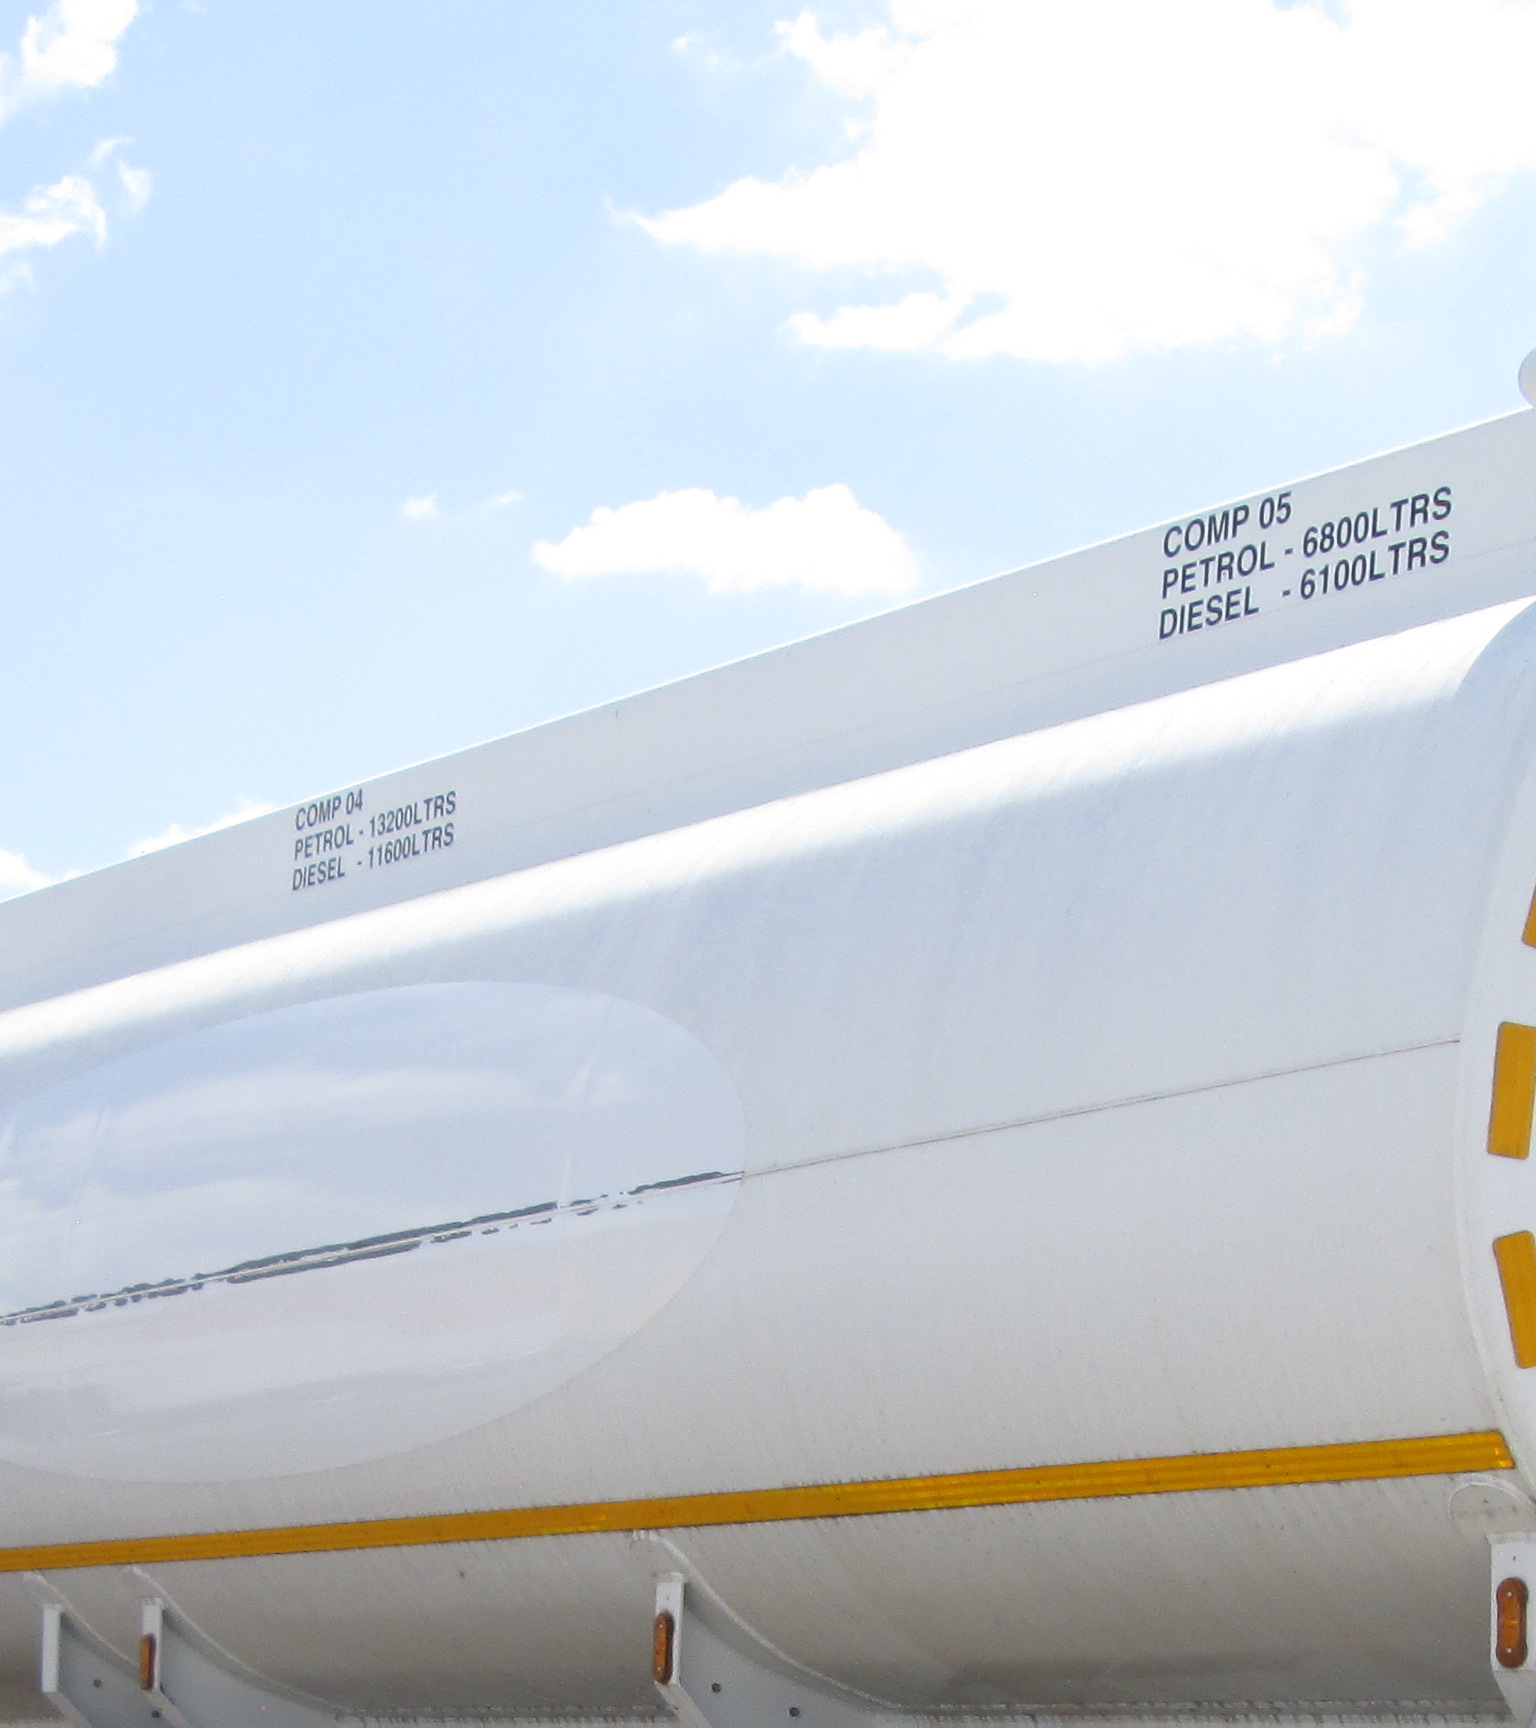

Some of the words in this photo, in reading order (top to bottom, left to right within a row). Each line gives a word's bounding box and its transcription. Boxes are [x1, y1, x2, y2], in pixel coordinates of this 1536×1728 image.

[1162, 541, 1275, 599] PETROL
[1302, 486, 1452, 558] 6800LTRS
[1164, 504, 1250, 558] COMP
[1258, 491, 1293, 530] 05
[1159, 586, 1260, 640] DIESEL
[1300, 530, 1450, 599] 6100LTRS
[294, 823, 354, 861] PETROL
[369, 790, 457, 838] 13200LTRS
[295, 795, 342, 831] COMP
[345, 789, 363, 815] 04
[292, 857, 346, 891] DIESEL
[367, 822, 455, 869] 11600LTRS
